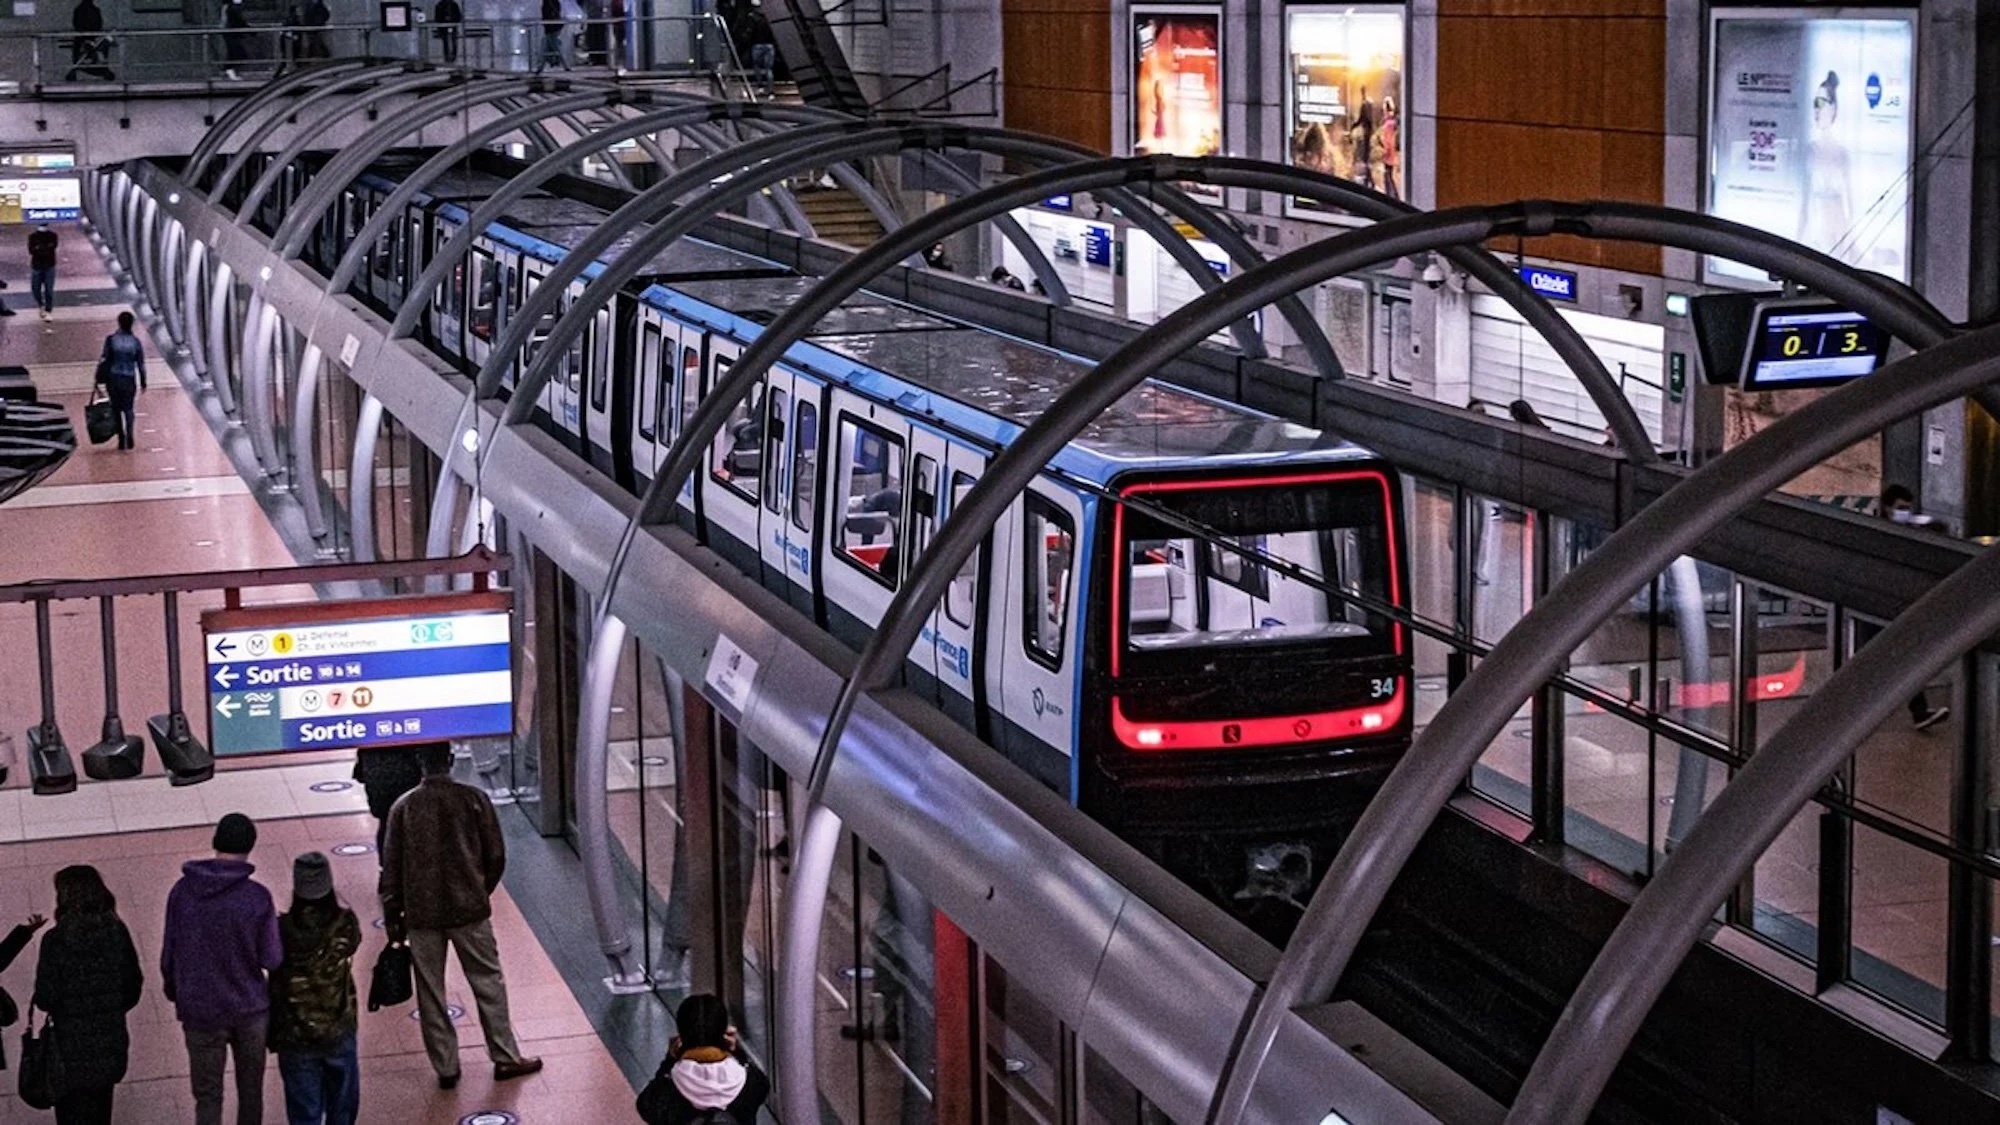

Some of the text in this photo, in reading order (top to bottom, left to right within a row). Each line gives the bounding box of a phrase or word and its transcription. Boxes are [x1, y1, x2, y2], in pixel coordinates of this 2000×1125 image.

[1531, 272, 1570, 294] Châtelet
[1783, 335, 1801, 357] 0
[1840, 331, 1859, 353] 3
[246, 662, 313, 685] Sortie
[1370, 677, 1395, 698] 34
[332, 692, 342, 706] 7
[299, 719, 367, 743] Sortie
